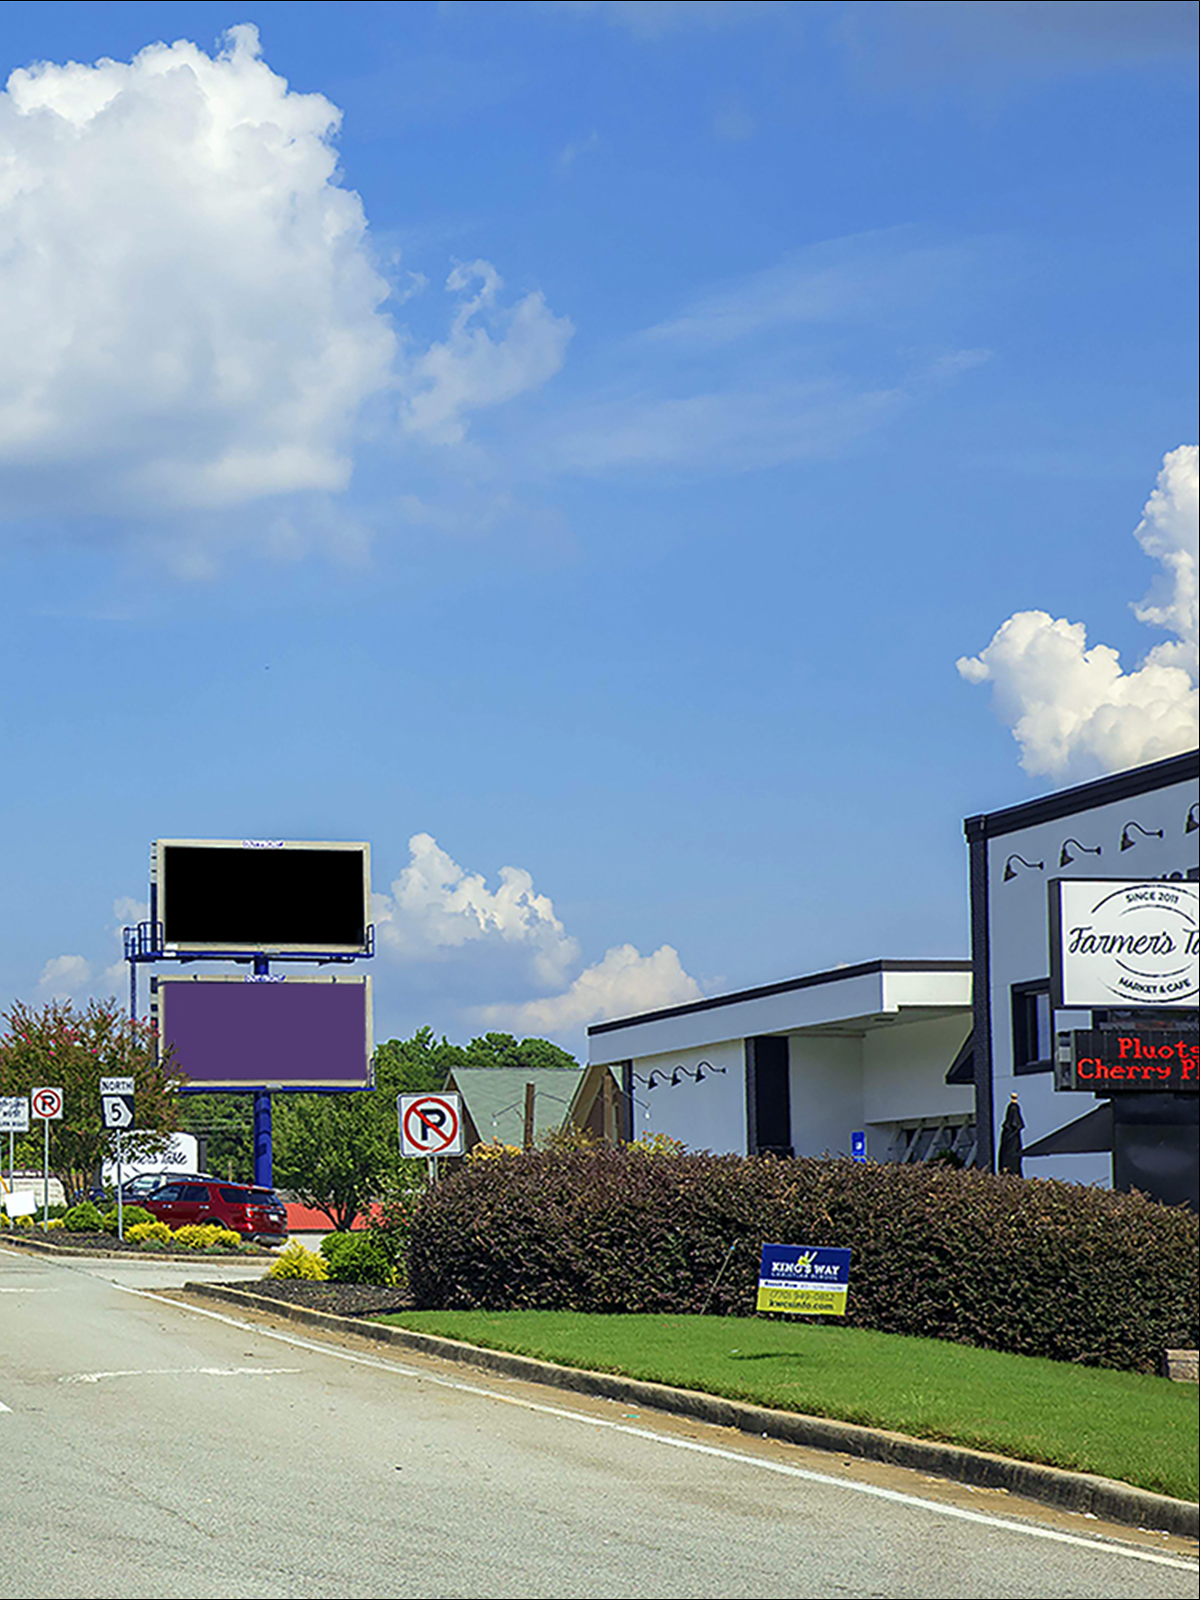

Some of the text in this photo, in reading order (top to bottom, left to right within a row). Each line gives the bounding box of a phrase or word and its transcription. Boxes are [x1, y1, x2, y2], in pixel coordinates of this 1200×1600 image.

[1125, 891, 1156, 903] SINCE
[1068, 926, 1177, 955] Farmer's
[1118, 977, 1157, 993] MARKET
[1117, 1037, 1199, 1059] Pluots
[1077, 1058, 1172, 1079] Cherry
[101, 1081, 133, 1091] NORTH
[111, 1103, 122, 1122] 5
[813, 1264, 841, 1275] WAY
